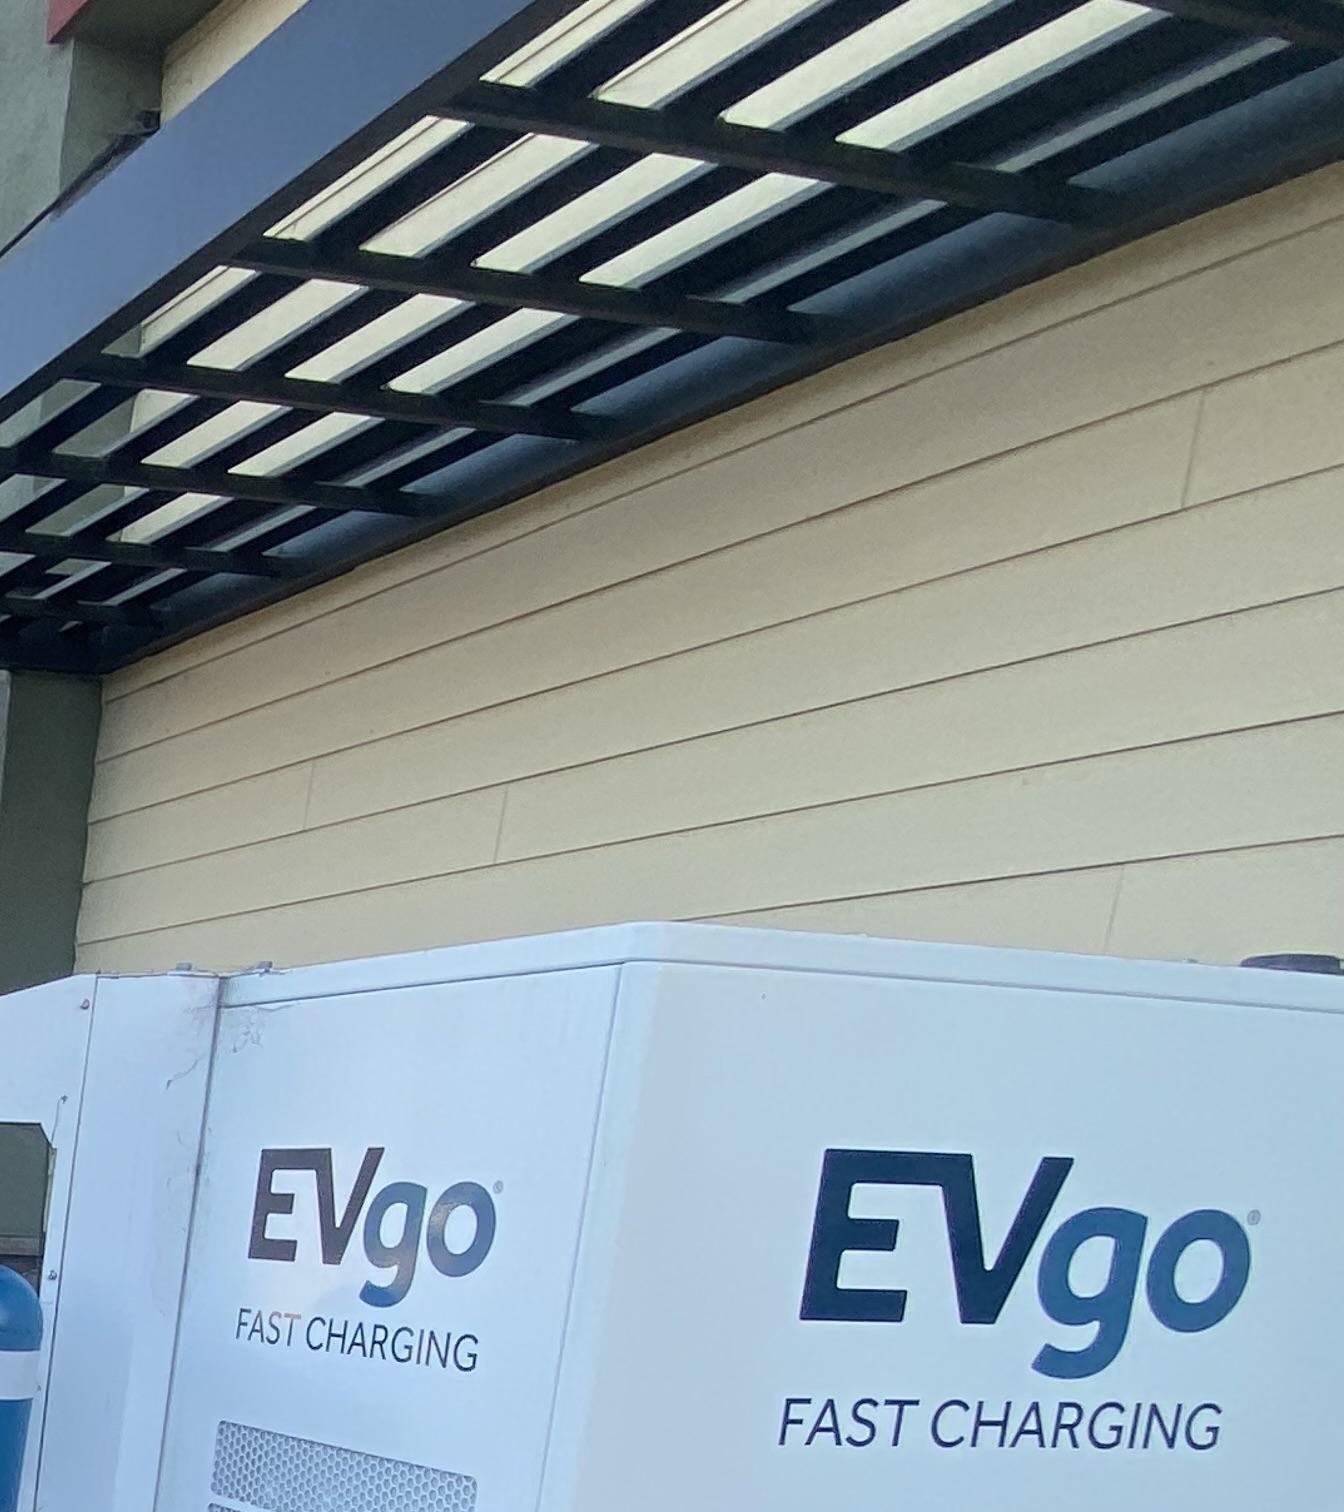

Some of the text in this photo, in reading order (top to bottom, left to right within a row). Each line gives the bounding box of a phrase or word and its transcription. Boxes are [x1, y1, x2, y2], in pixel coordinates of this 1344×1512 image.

[247, 1147, 496, 1308] EVgo
[800, 1148, 1252, 1379] EVgo
[235, 1308, 479, 1372] FAST CHARGING
[778, 1397, 1223, 1450] FAST CHARGING
